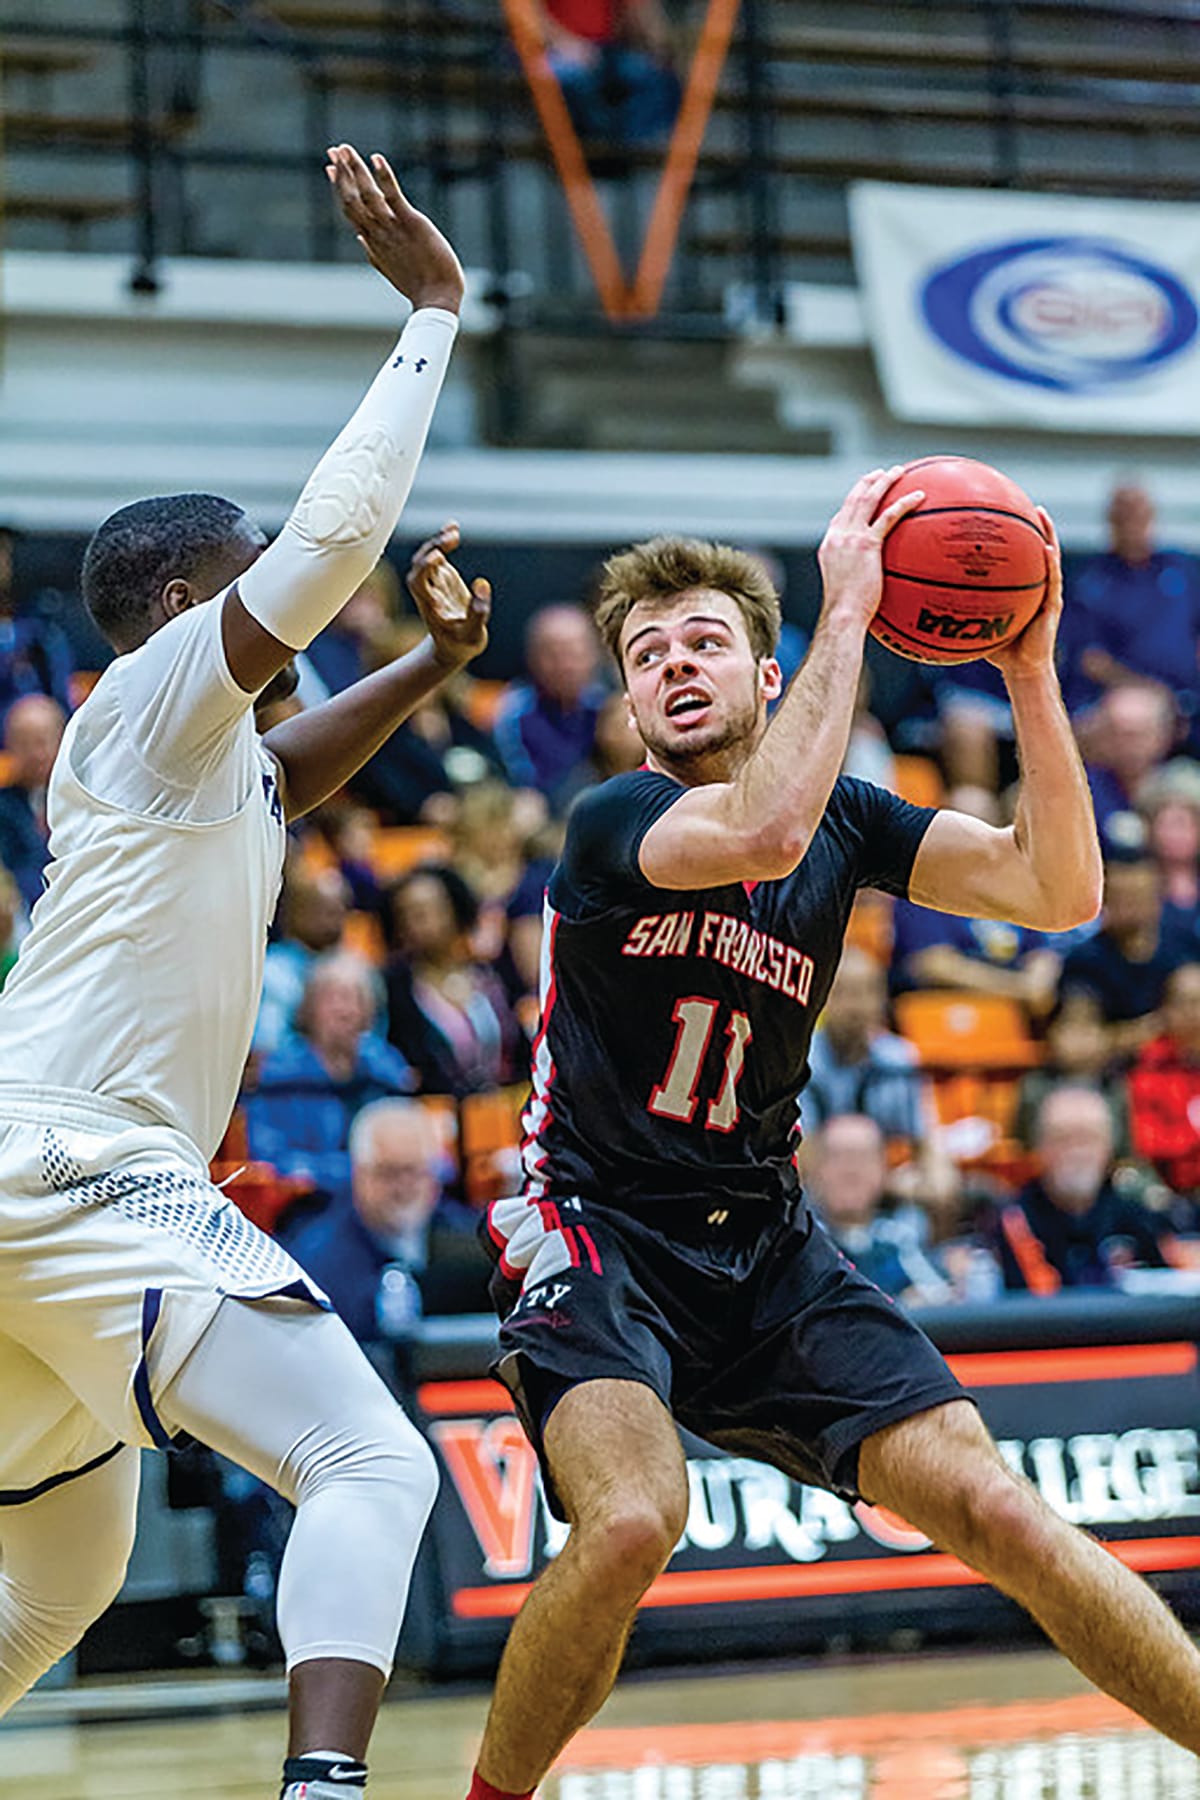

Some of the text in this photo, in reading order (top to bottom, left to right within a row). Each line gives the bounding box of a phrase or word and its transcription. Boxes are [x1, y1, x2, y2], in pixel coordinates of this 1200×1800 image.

[916, 608, 1016, 640] NCAA
[622, 911, 815, 1007] SAN FRANSCO
[647, 995, 753, 1133] 11
[430, 1416, 859, 1579] VURA
